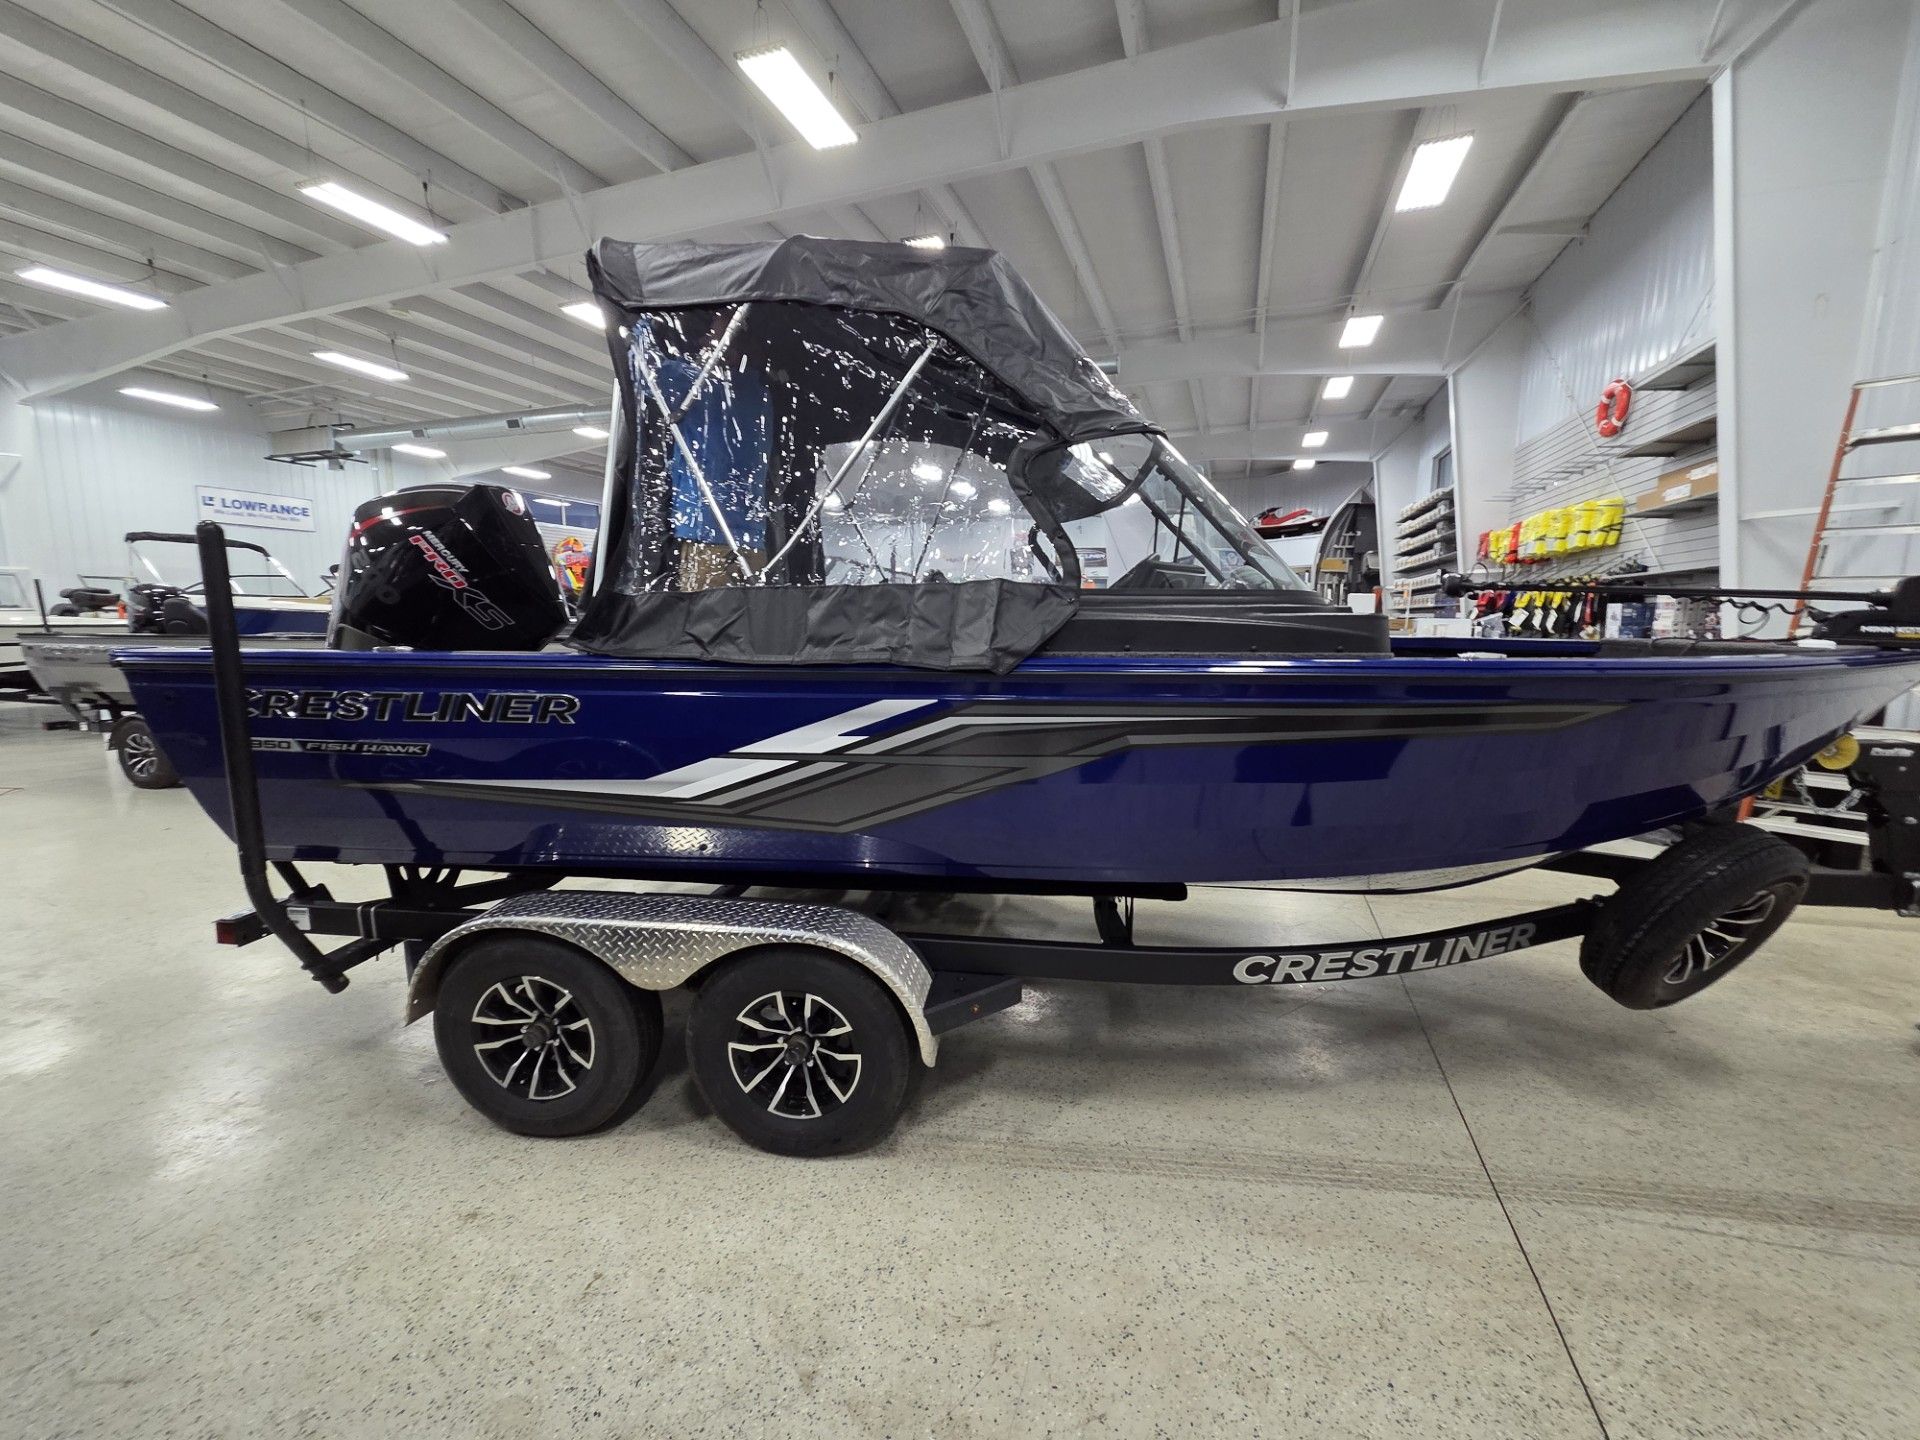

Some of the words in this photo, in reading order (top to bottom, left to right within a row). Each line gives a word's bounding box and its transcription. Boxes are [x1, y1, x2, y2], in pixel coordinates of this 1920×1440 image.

[221, 497, 310, 517] LOWRANCE
[408, 534, 469, 589] PRO
[422, 530, 470, 573] MERCURY
[427, 573, 516, 631] XS
[306, 742, 357, 752] FISH
[362, 743, 423, 754] HAWK
[1232, 922, 1537, 985] CRESTLINER
